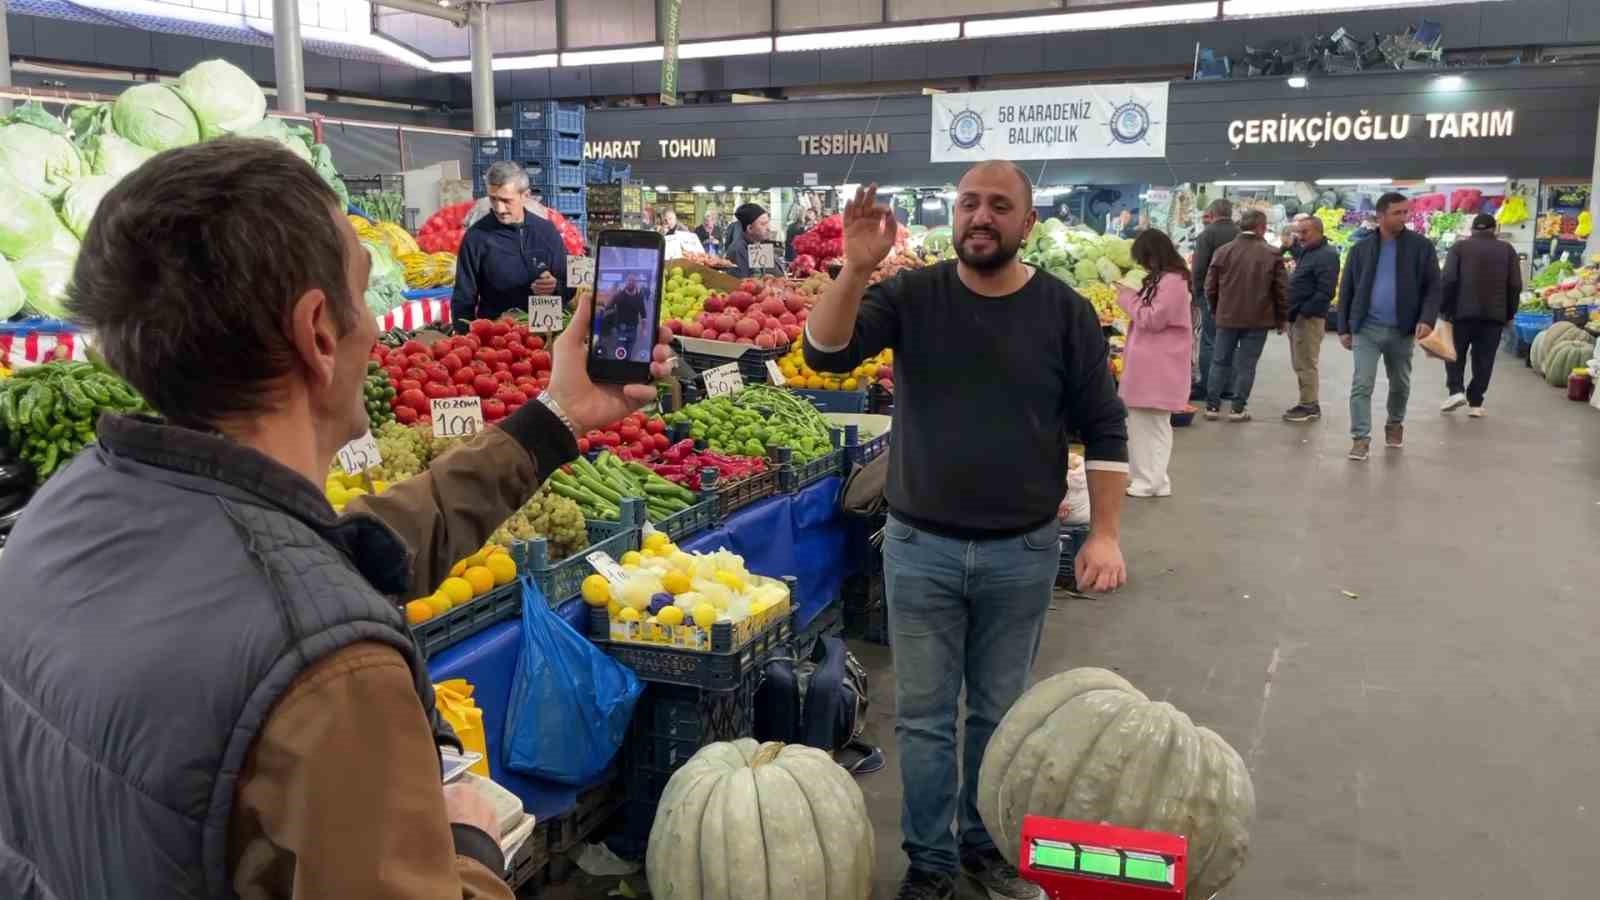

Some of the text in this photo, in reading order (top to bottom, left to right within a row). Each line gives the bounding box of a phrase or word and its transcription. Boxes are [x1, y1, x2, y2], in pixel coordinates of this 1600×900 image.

[998, 98, 1092, 123] 58 KARADENİZ
[1008, 125, 1078, 145] BALIKÇILIK
[1227, 109, 1514, 150] ÇERİKÇİOĞLU TARIM
[659, 138, 717, 159] TOHUM
[798, 130, 889, 155] TESBİHAN
